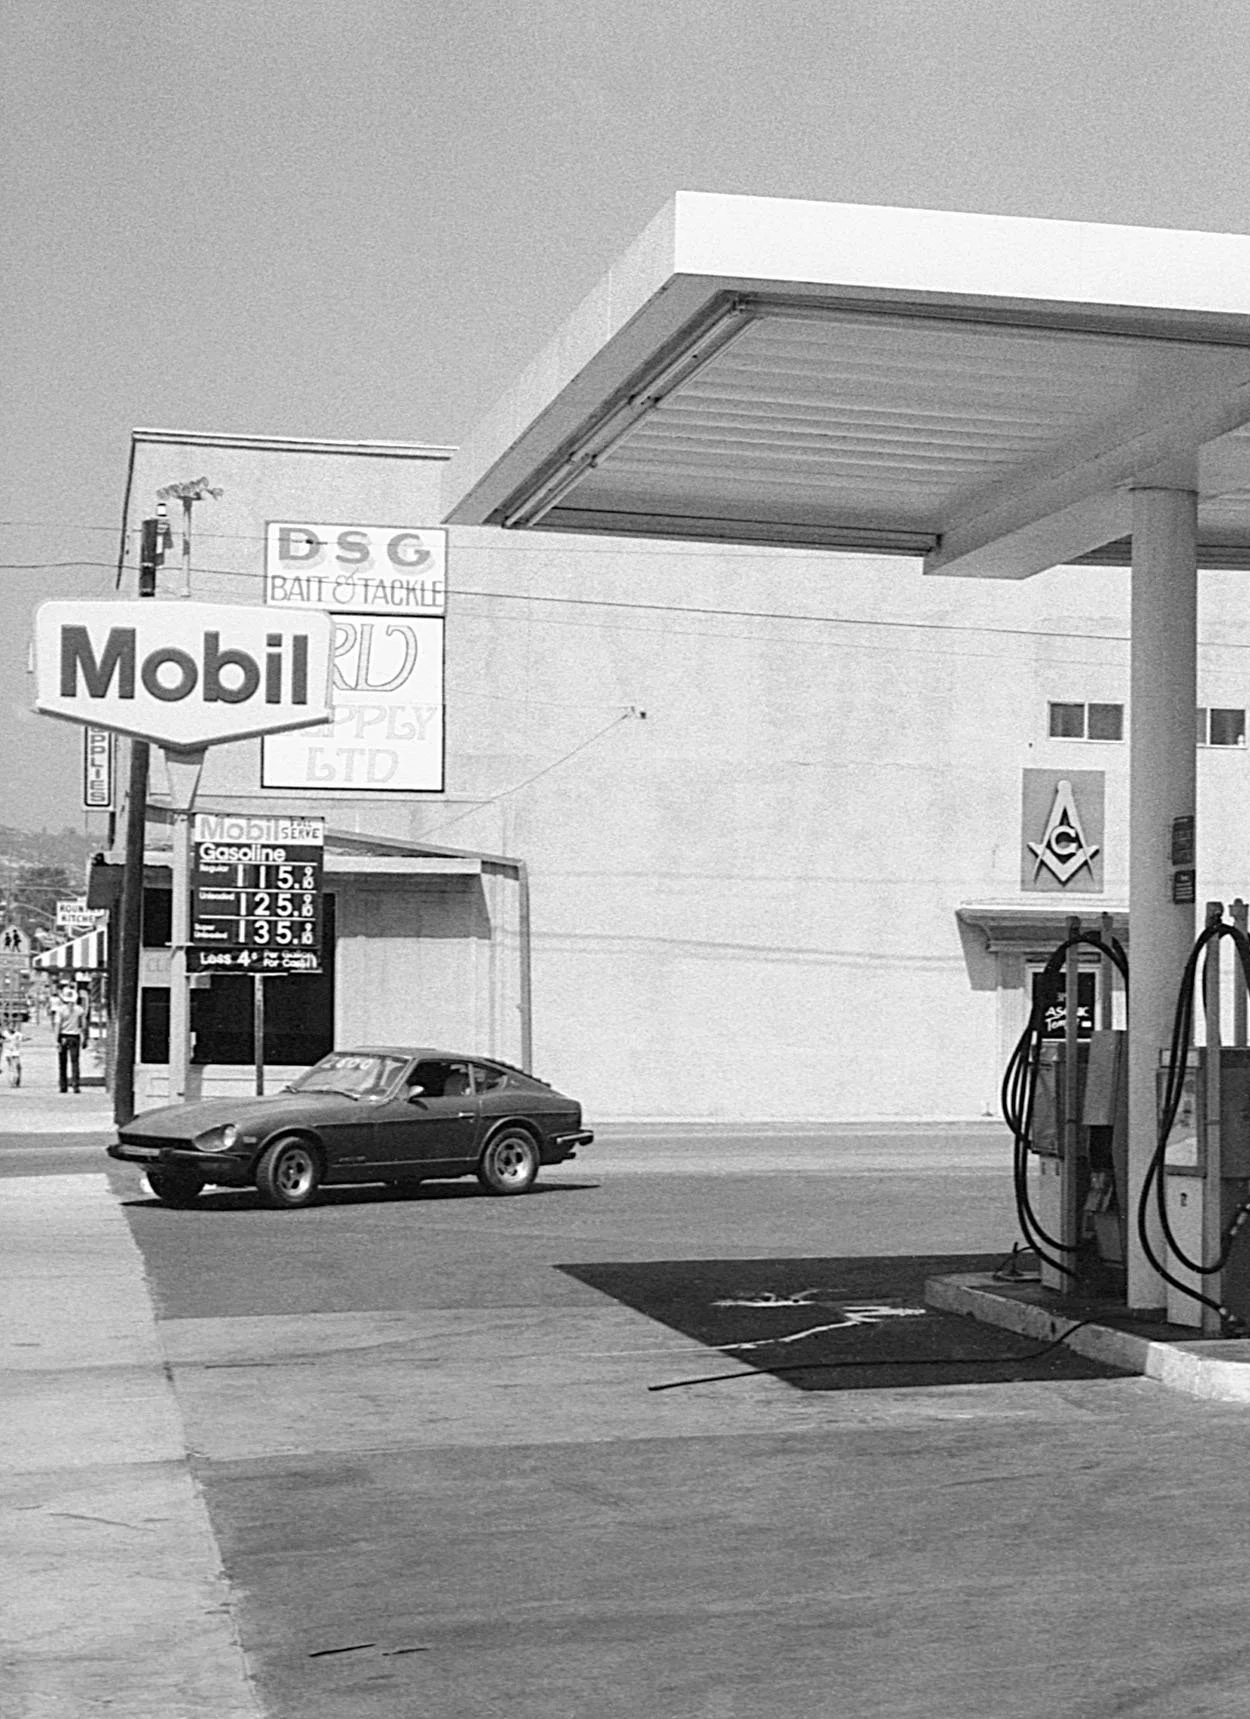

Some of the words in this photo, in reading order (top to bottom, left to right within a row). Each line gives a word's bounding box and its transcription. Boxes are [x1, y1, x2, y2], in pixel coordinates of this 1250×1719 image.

[270, 575, 329, 602] BAIT
[357, 577, 444, 607] TACKLE
[60, 624, 308, 704] Mobil
[306, 747, 400, 784] LTD
[200, 817, 280, 841] Mobil
[281, 827, 321, 840] SERVE
[200, 843, 287, 862] Gasoline
